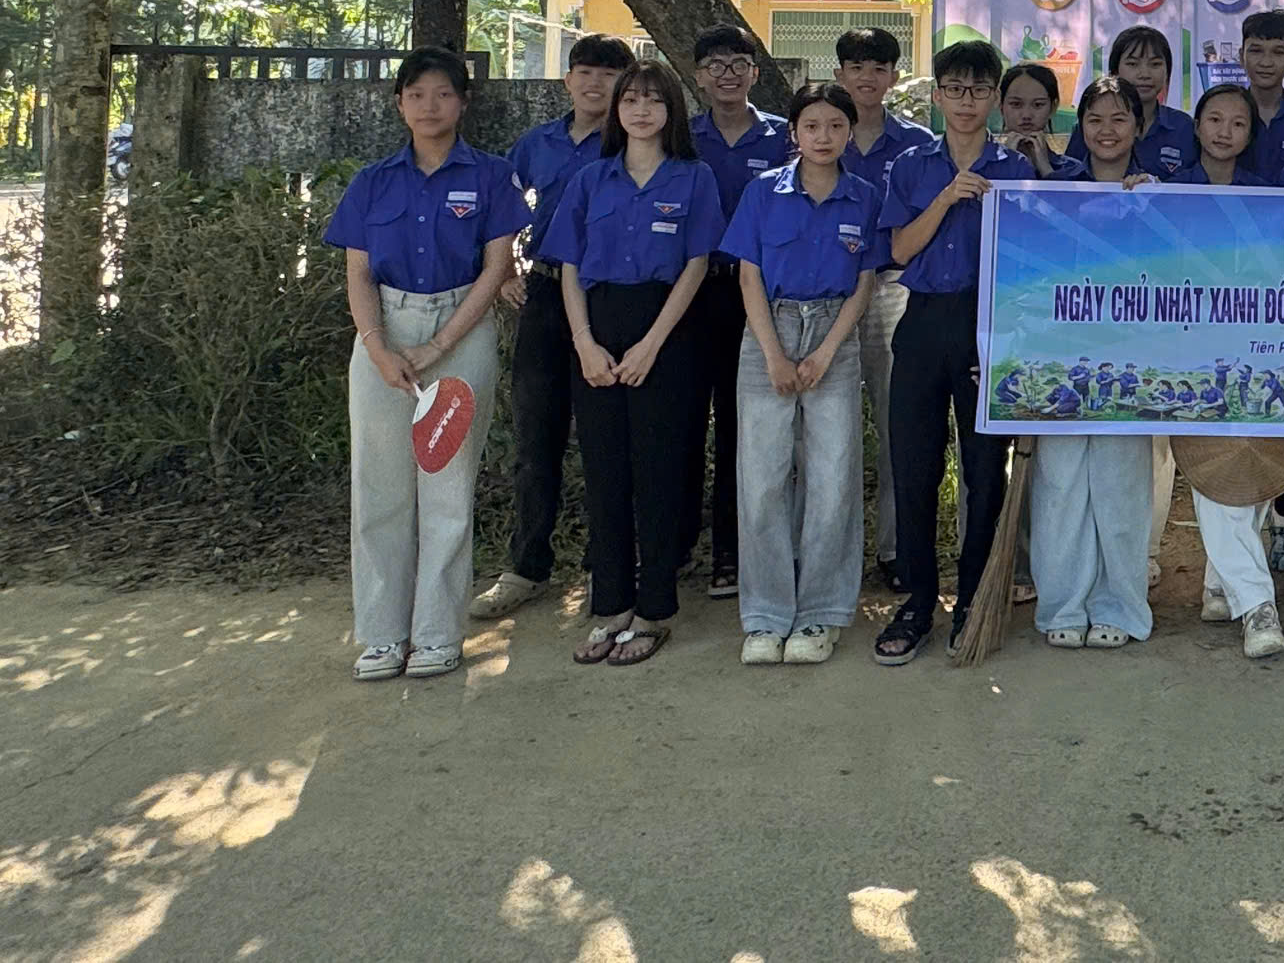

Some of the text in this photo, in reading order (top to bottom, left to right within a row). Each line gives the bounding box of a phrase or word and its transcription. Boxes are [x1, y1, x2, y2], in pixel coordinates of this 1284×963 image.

[1054, 278, 1105, 322] NGÀY
[1111, 275, 1149, 322] CHỦ
[1154, 279, 1203, 331] NHẬT
[1209, 287, 1259, 324] XANH
[1250, 341, 1275, 354] Tiên
